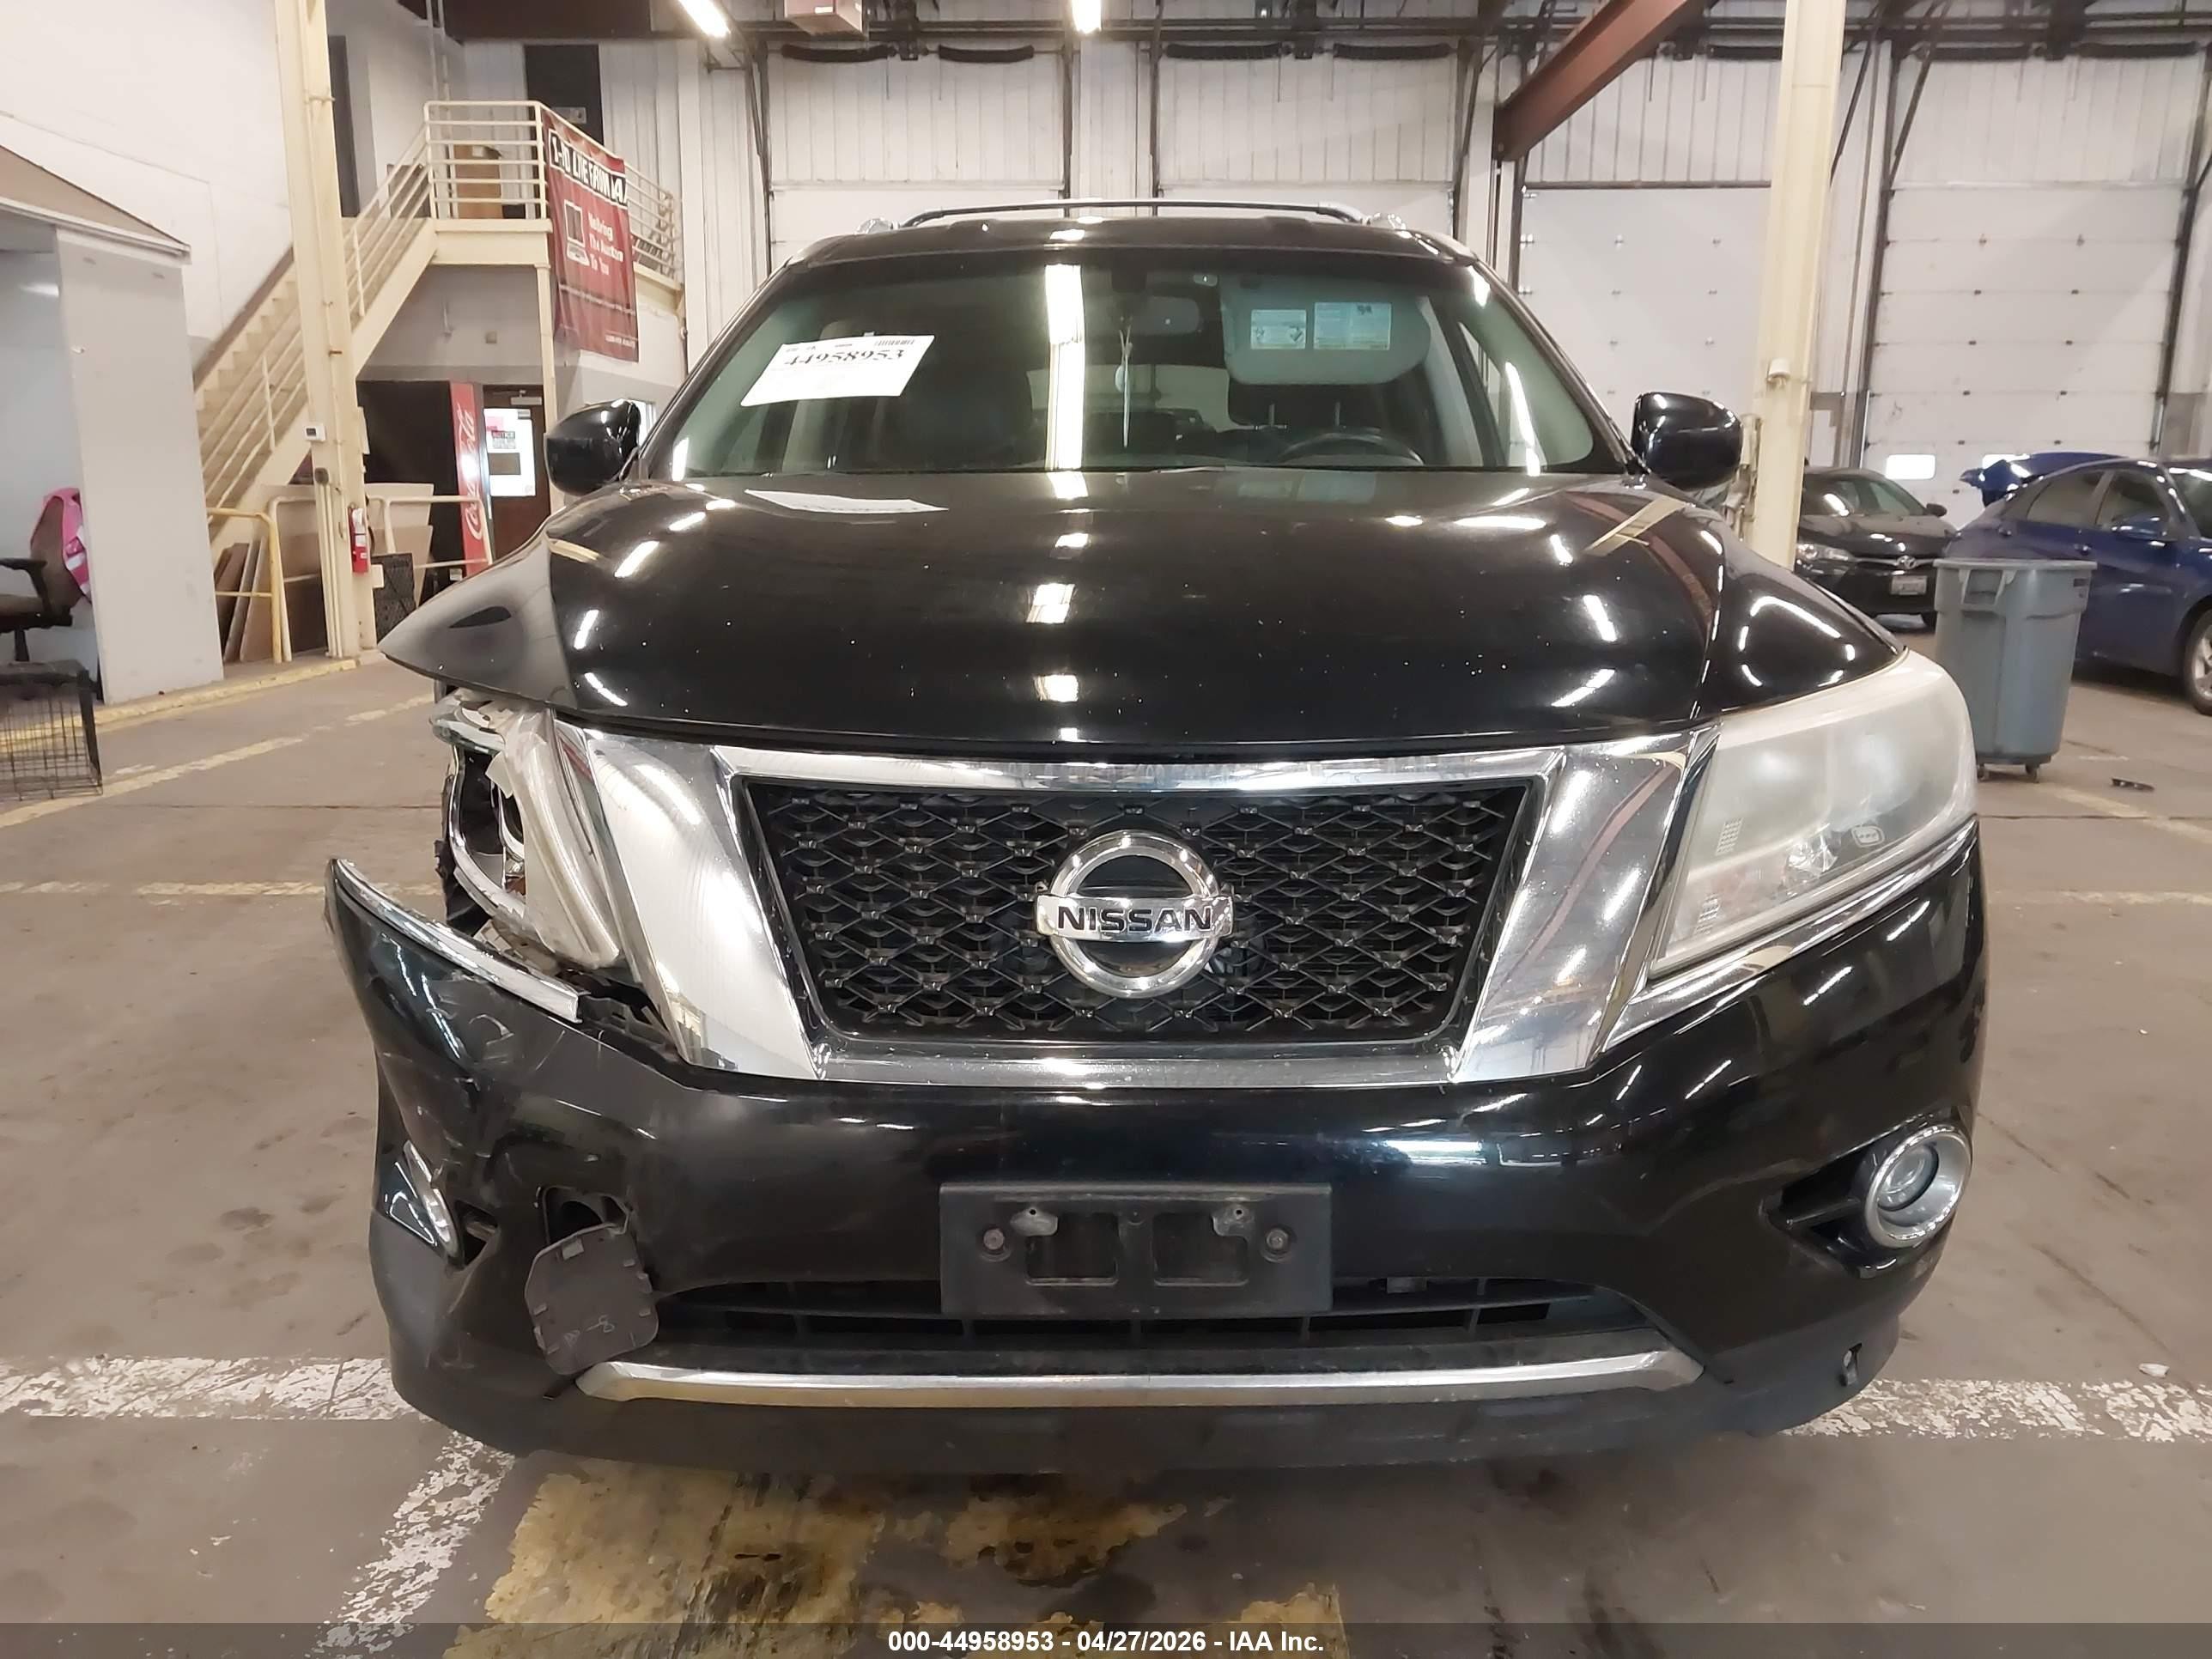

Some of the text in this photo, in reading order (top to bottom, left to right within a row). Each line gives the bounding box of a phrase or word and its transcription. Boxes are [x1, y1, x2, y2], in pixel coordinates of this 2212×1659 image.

[783, 349, 905, 366] 44958953
[457, 402, 483, 541] Cocaola
[1056, 905, 1213, 933] NISSAN
